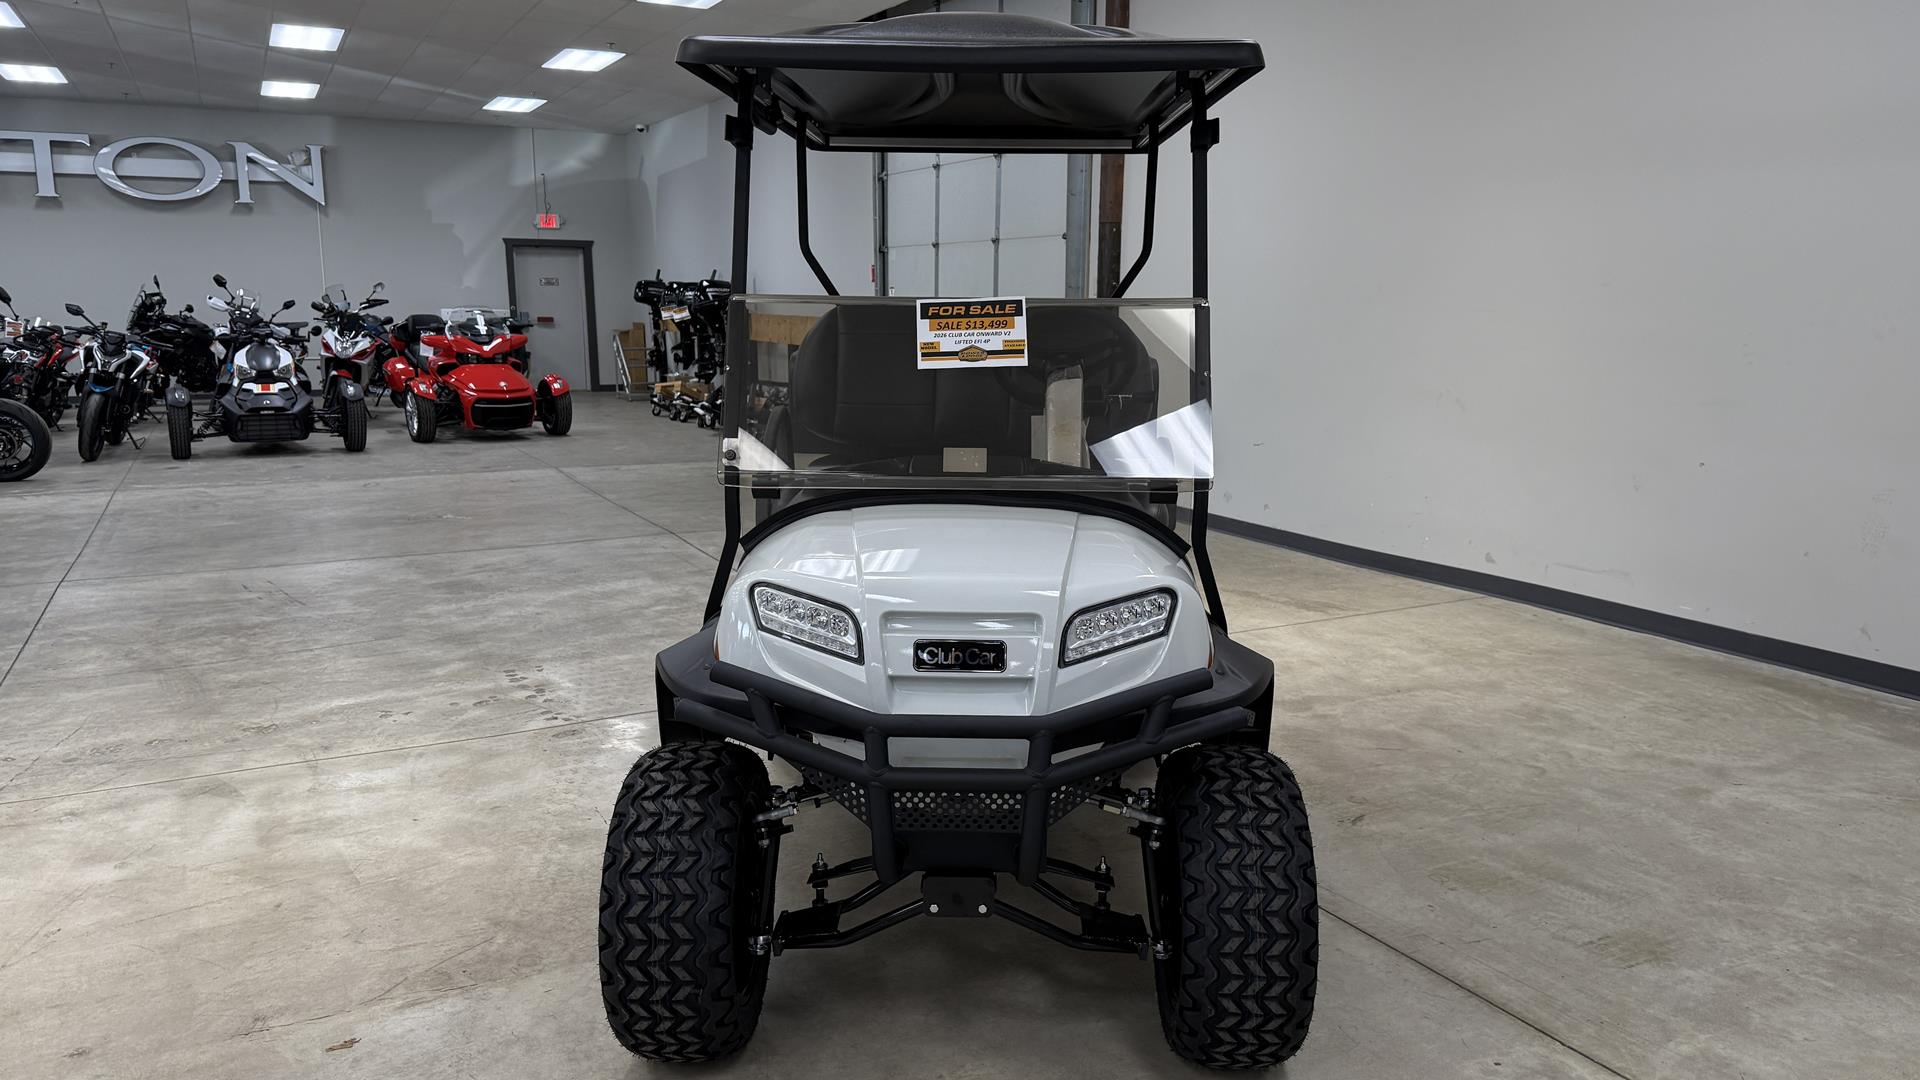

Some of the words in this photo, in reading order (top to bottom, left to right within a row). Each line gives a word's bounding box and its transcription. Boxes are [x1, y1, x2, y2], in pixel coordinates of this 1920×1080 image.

[928, 305, 964, 316] FOR
[969, 304, 1016, 314] SALE
[936, 321, 962, 331] SALE
[965, 319, 1007, 331] $13,499
[924, 647, 963, 665] Club
[965, 647, 996, 665] Car
